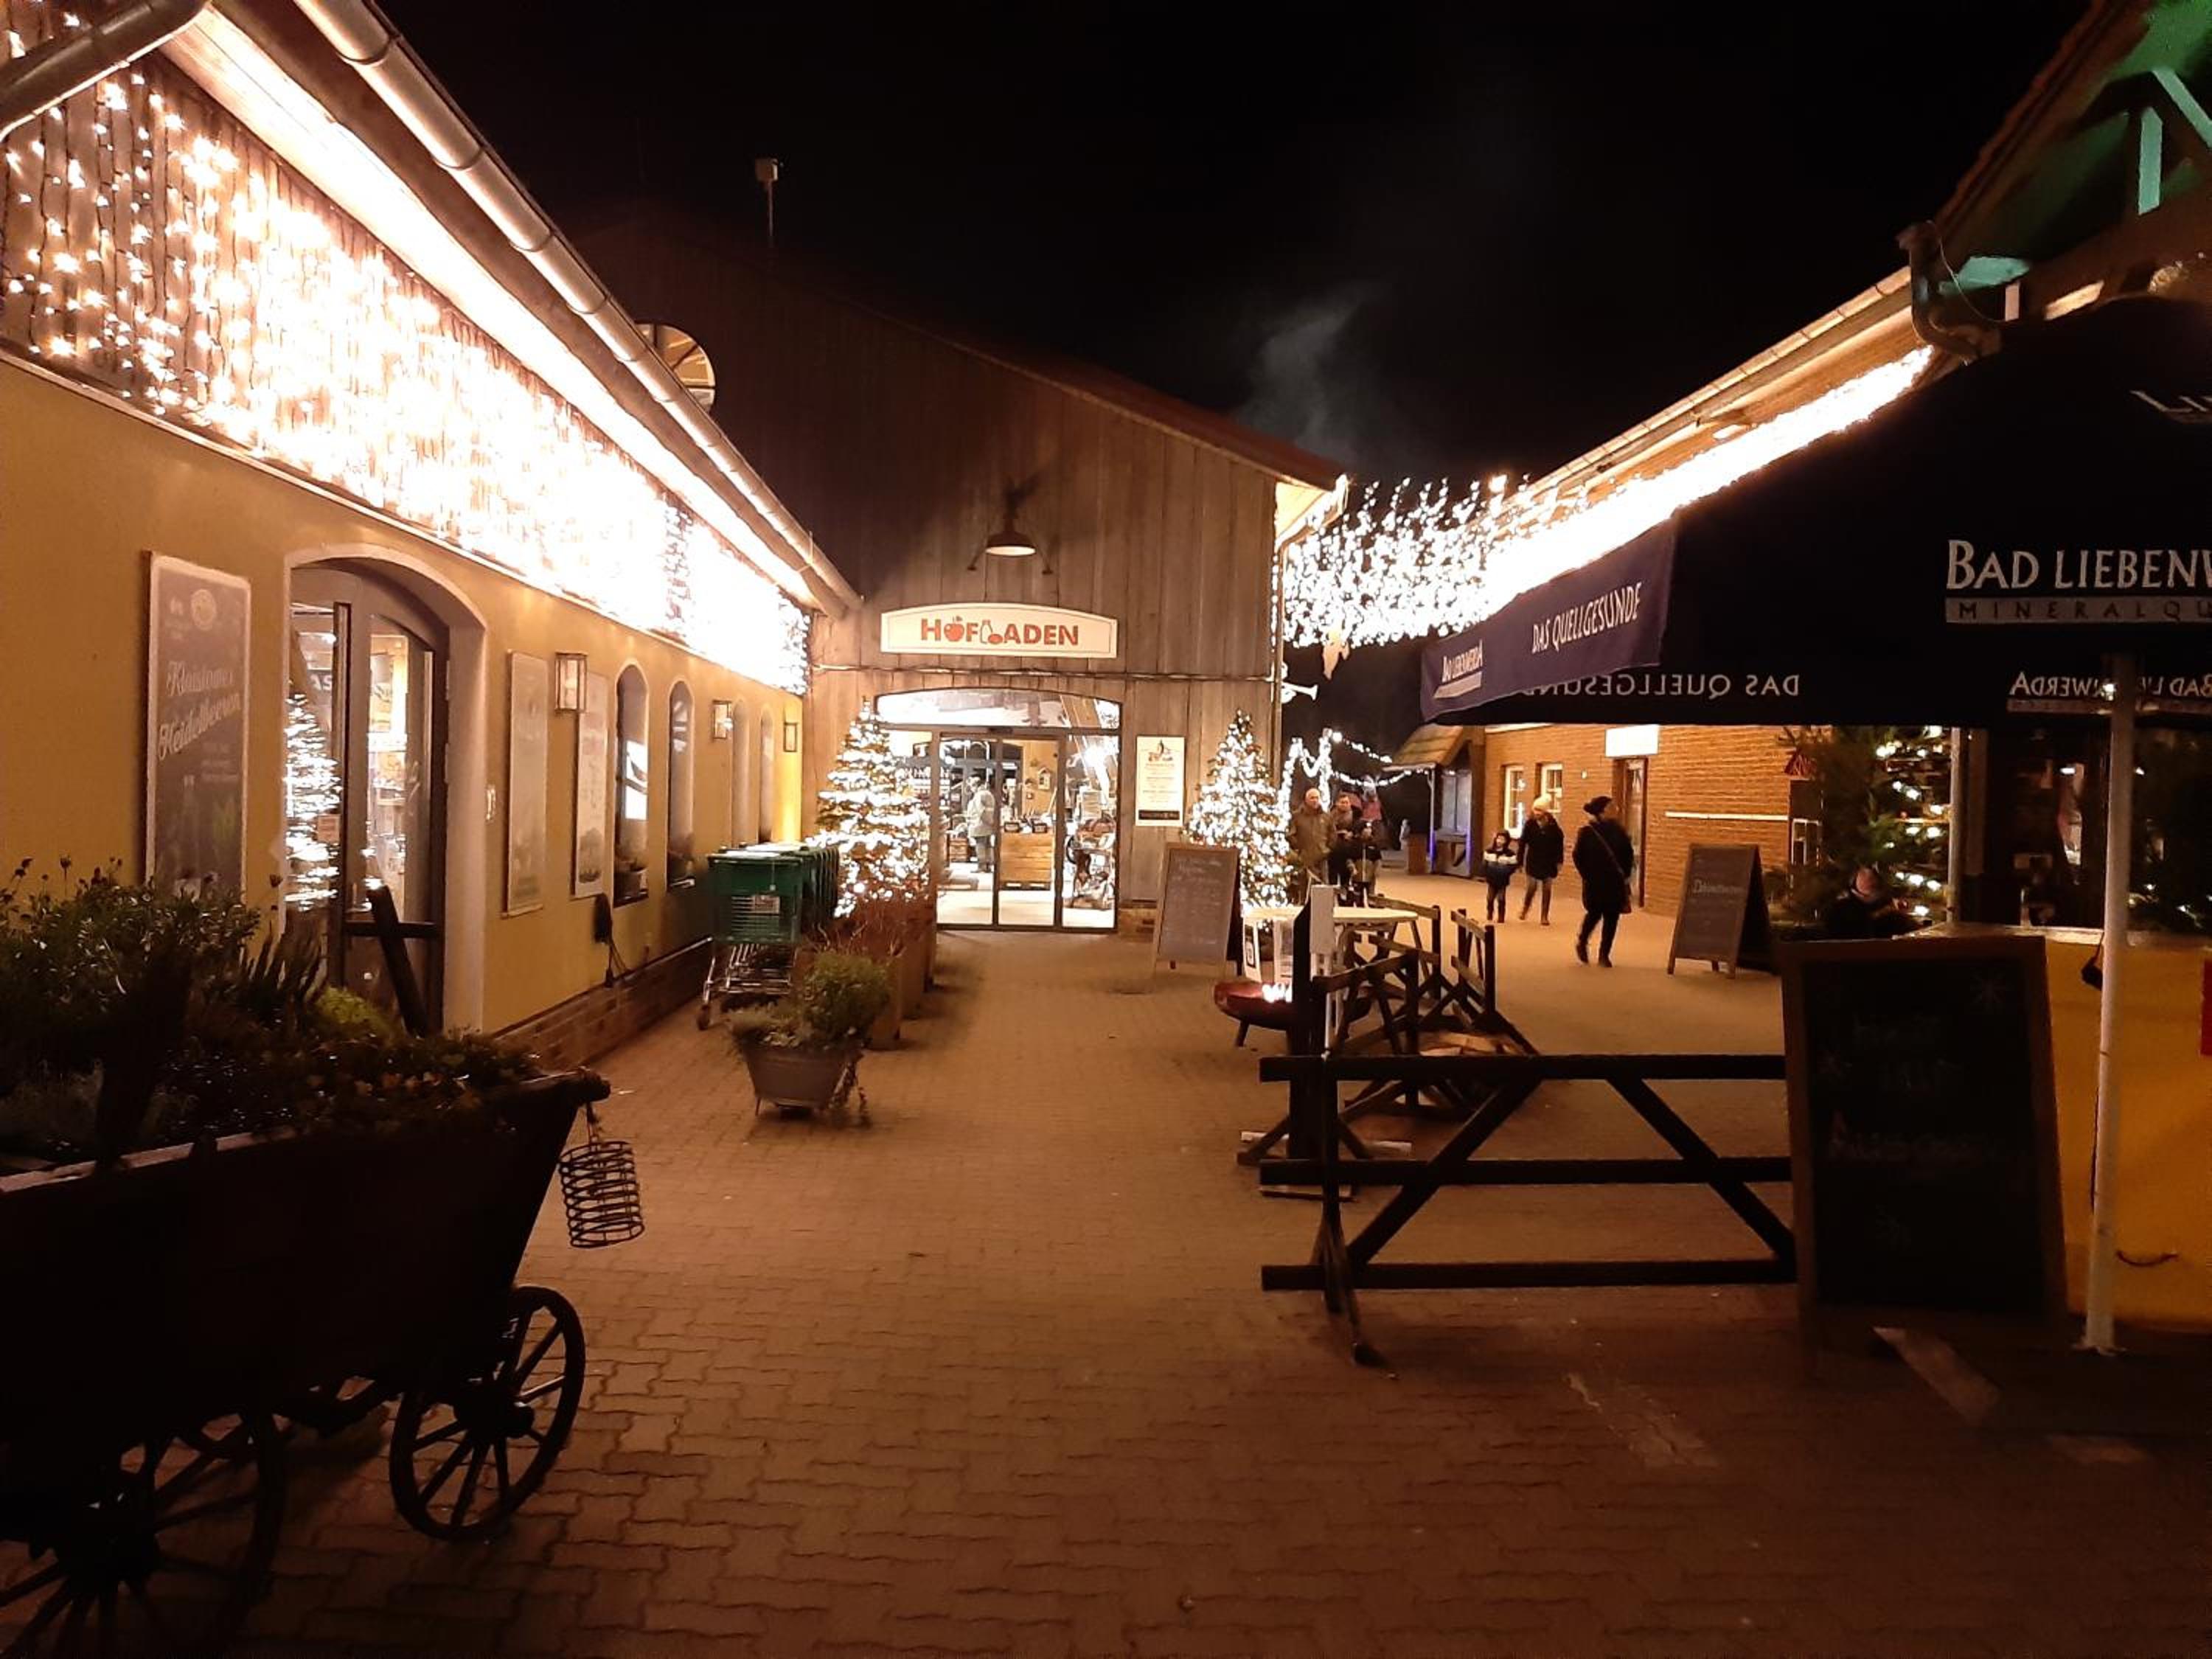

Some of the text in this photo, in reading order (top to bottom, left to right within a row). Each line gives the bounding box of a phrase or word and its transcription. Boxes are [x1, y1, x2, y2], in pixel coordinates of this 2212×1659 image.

[1946, 539, 2039, 589] BAD
[1532, 582, 1643, 655] DAS QUELLGESUNDE
